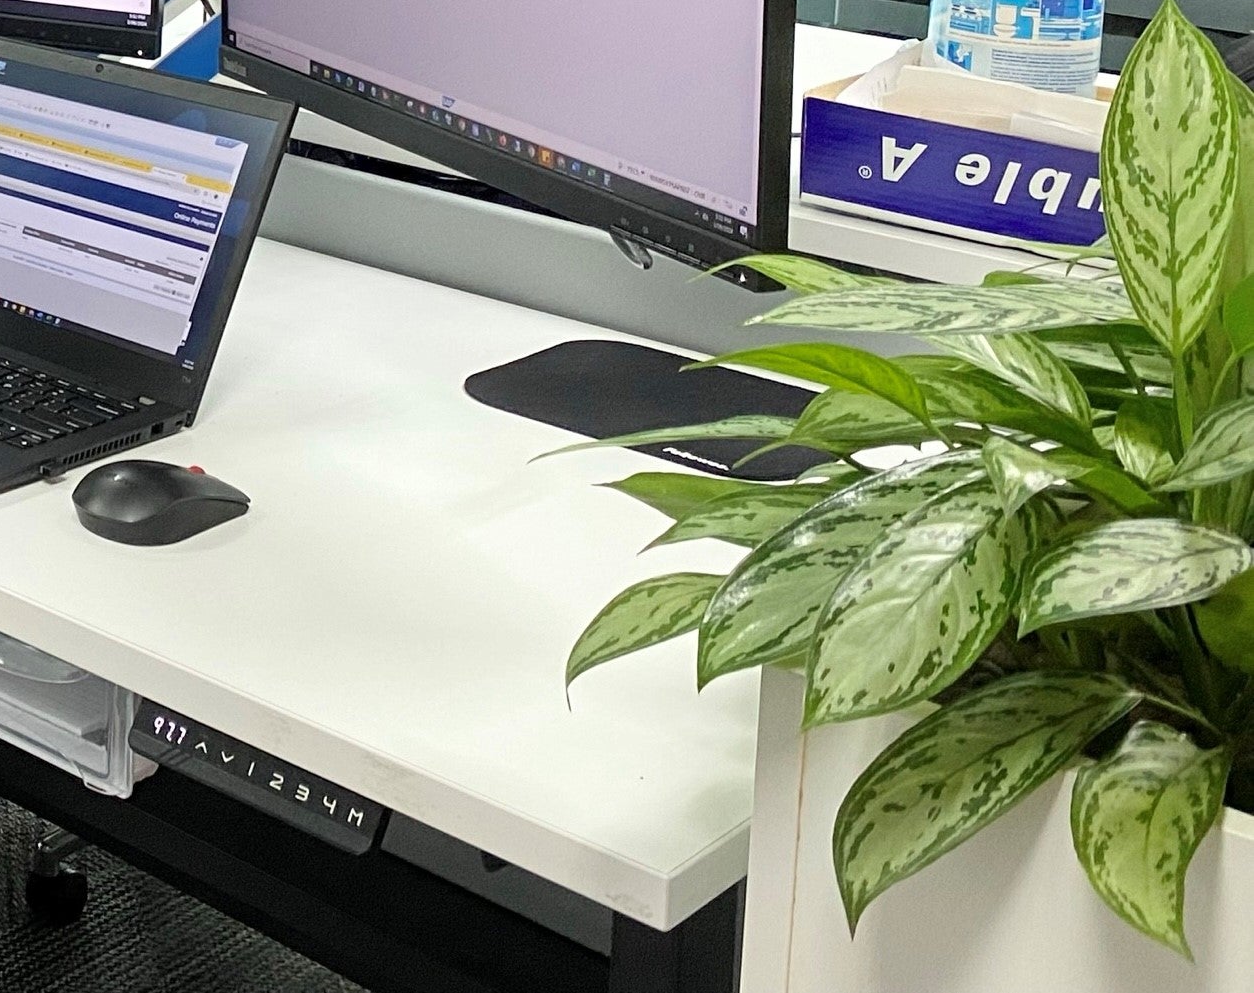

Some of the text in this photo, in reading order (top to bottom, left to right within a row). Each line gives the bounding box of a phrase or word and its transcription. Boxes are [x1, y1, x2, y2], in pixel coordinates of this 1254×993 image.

[247, 762, 254, 776] 1
[269, 772, 284, 790] 2
[295, 784, 310, 802] 3
[322, 795, 337, 814] 4
[347, 808, 364, 826] M
